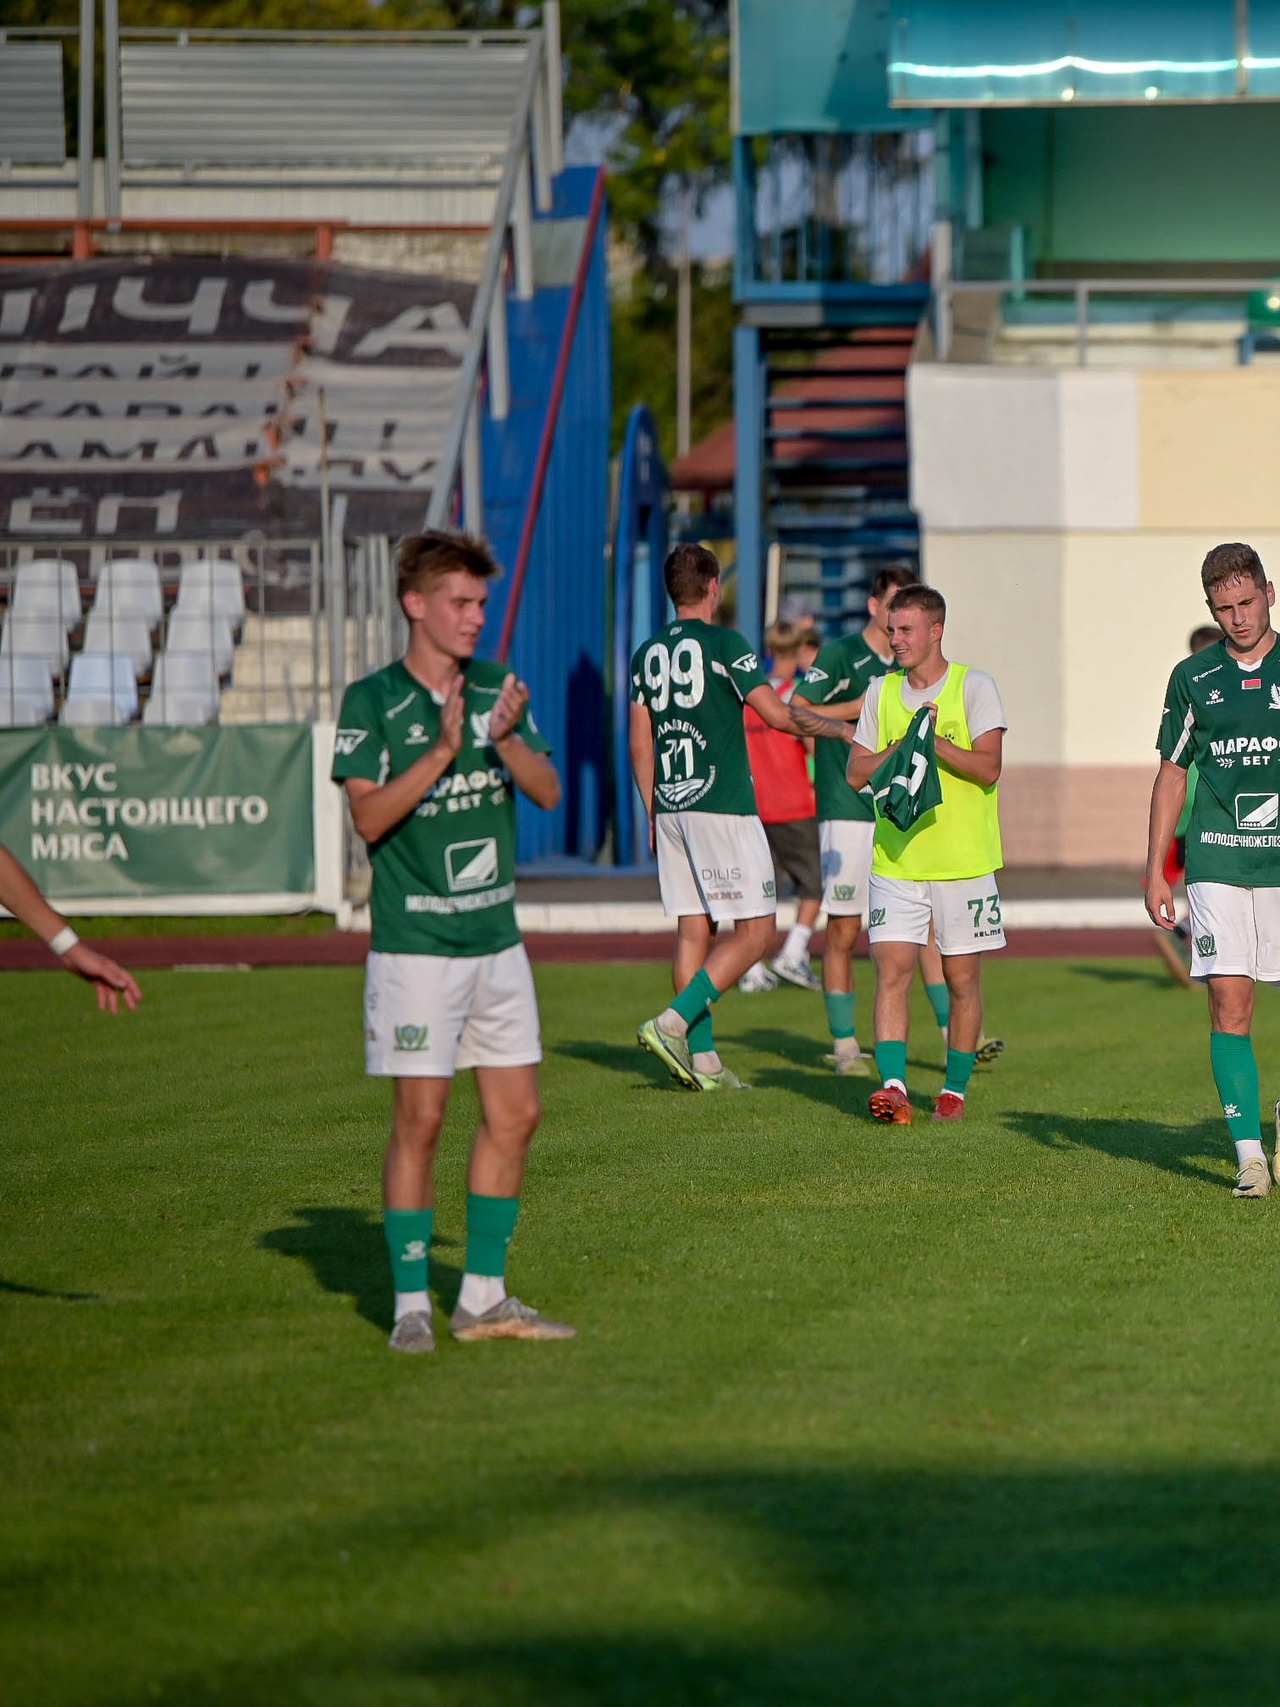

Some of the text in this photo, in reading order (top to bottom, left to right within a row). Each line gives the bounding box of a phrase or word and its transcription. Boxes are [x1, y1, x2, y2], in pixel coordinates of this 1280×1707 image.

[644, 638, 705, 712] 99
[1242, 756, 1271, 766] БЕТ
[31, 763, 117, 791] ВКУС
[31, 796, 268, 829] НАСТОЯЩЕГО
[446, 793, 482, 813] БЕТ
[31, 833, 129, 860] МЯСА
[702, 867, 741, 880] DILIS
[967, 894, 1001, 928] 73
